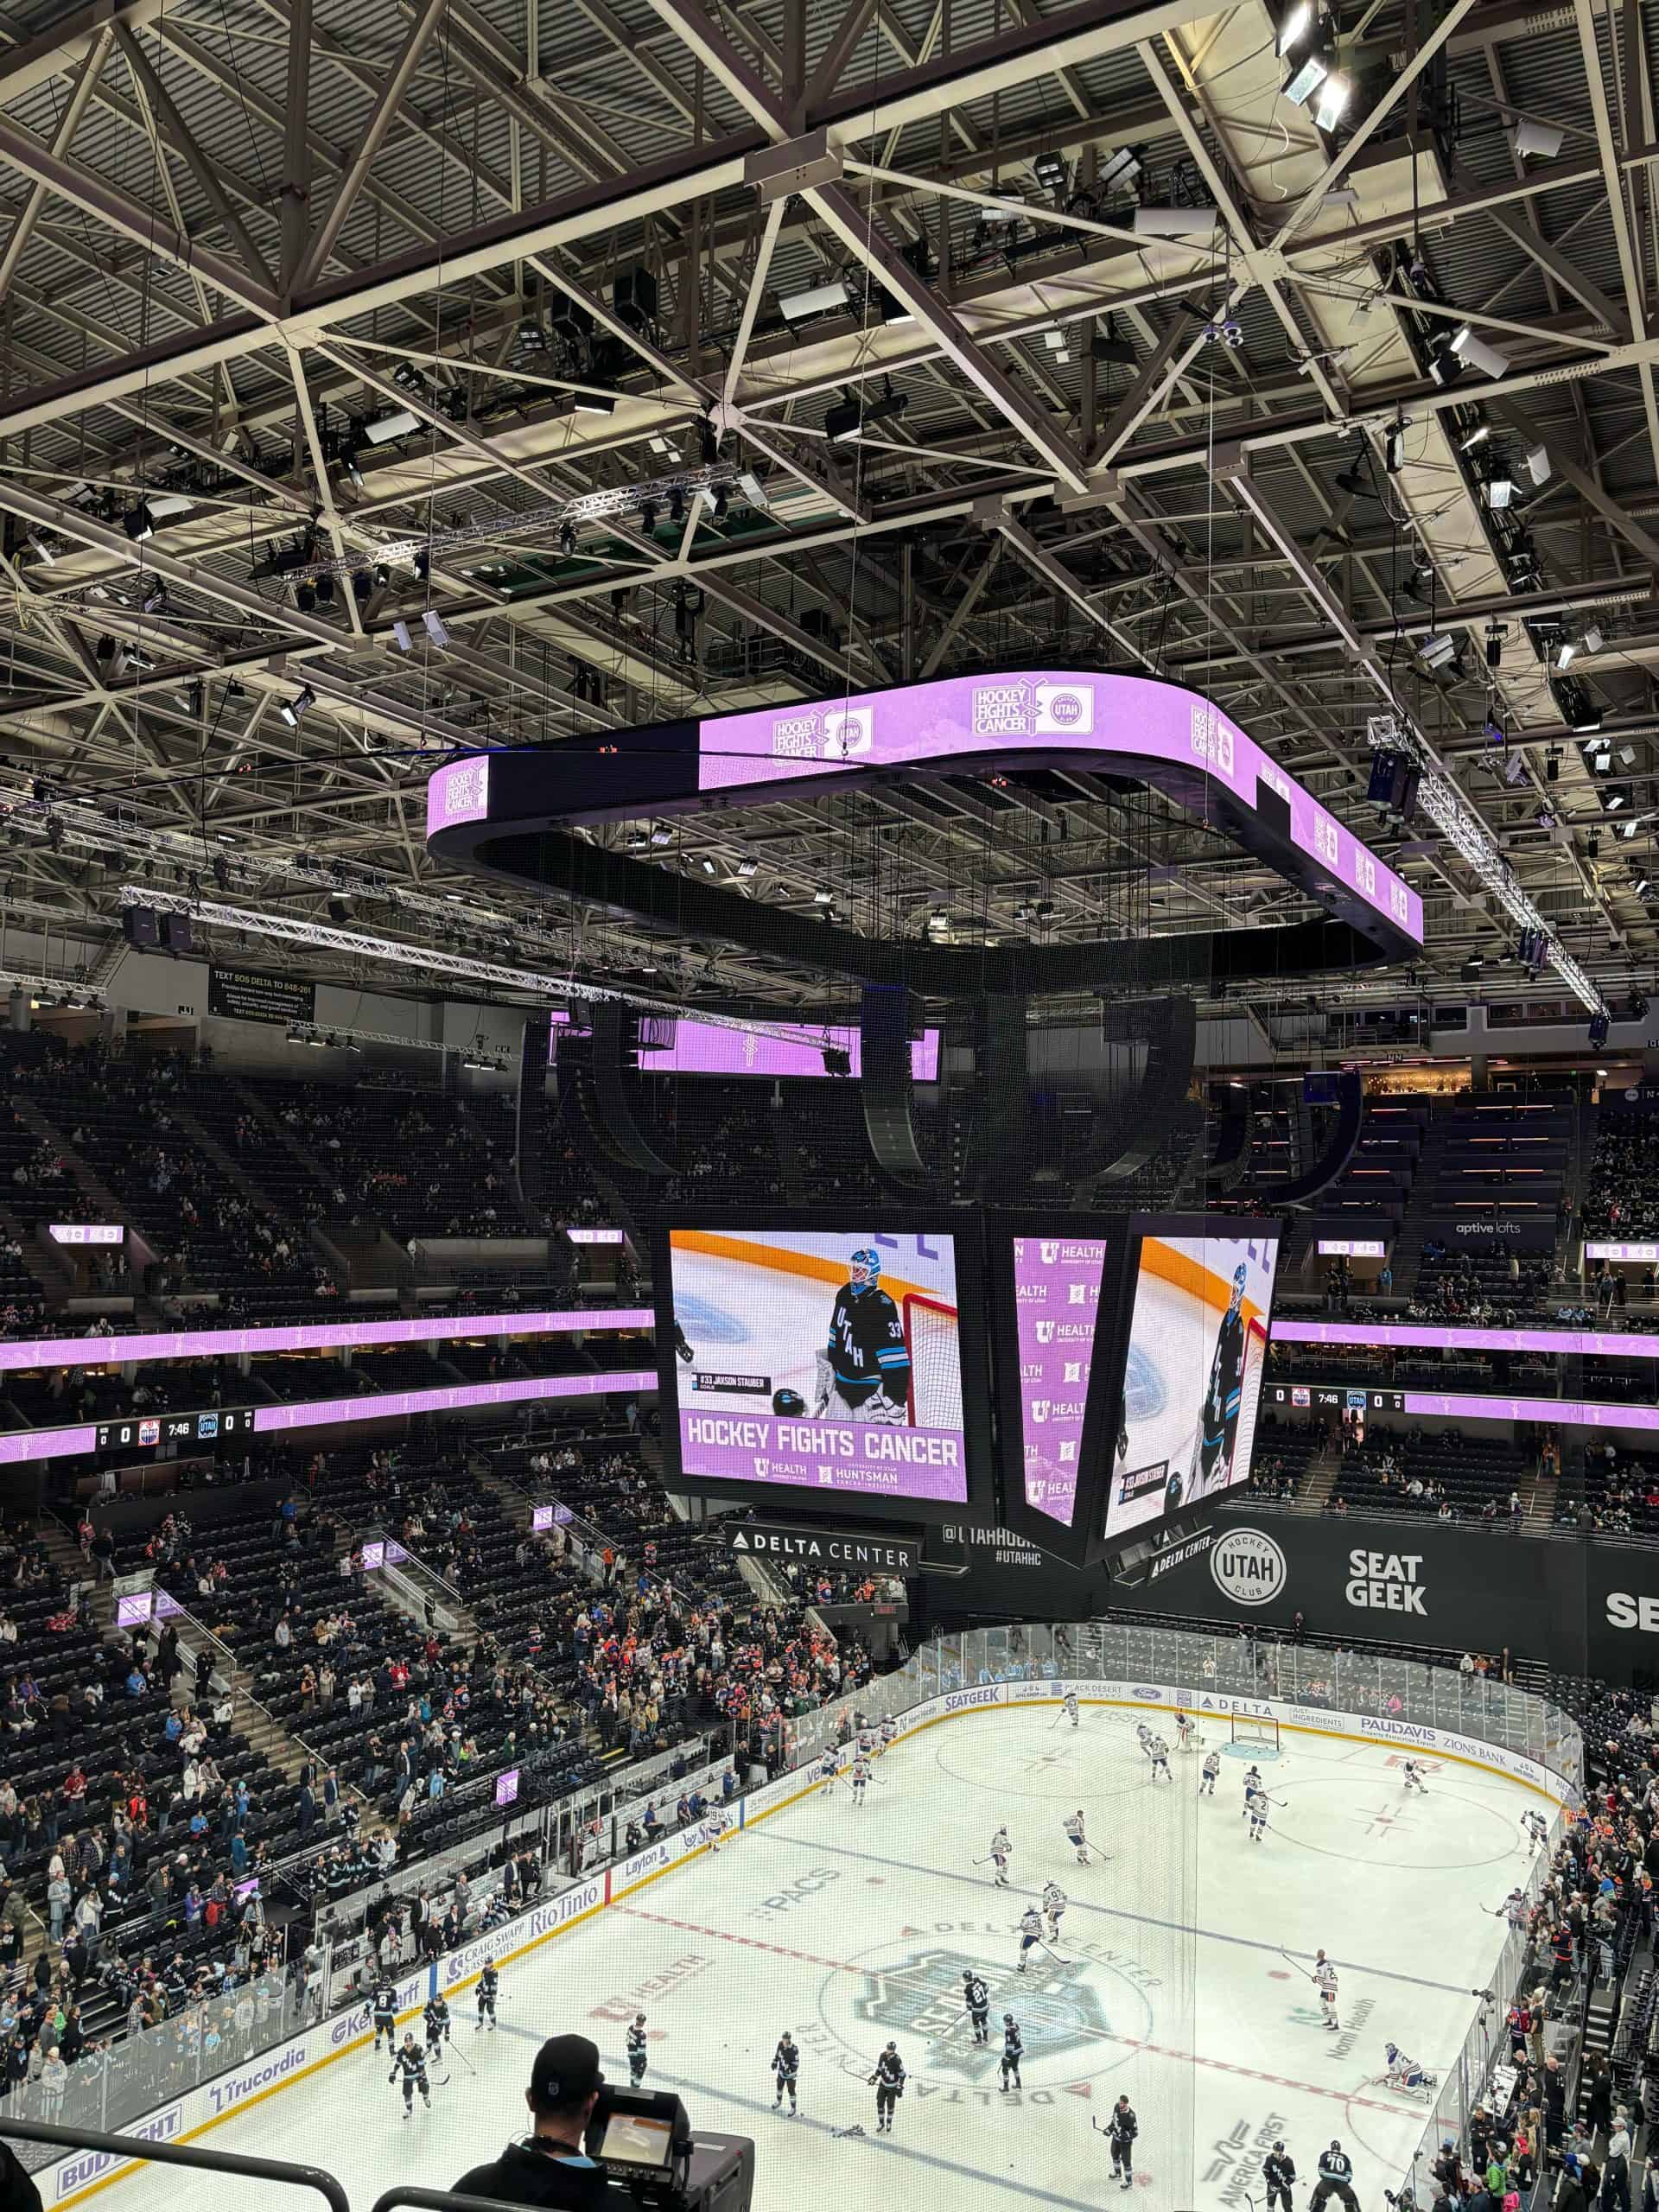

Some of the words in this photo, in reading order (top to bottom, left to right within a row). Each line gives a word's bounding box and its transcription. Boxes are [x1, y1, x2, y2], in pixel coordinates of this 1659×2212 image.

[977, 690, 1026, 704] HOCKEY
[977, 702, 1020, 719] FIGHTS
[1055, 704, 1078, 715] UTAH
[778, 719, 817, 734] HOCKEY
[976, 716, 1026, 733] CANCER
[777, 731, 812, 749] FIGHTS
[213, 969, 234, 981] TEXT
[234, 974, 250, 984] SOS
[251, 976, 272, 988] DELTA
[274, 981, 283, 989] TO
[1456, 1222, 1494, 1236] aptive
[1495, 1221, 1522, 1234] lofts
[1061, 1246, 1103, 1259] HEALTH
[887, 1321, 902, 1339] 33
[1275, 1389, 1285, 1402] 0
[1318, 1394, 1338, 1404] 7:46
[1349, 1395, 1364, 1405] UTAH
[1374, 1395, 1383, 1408] 0
[168, 1422, 189, 1437] 7:46
[200, 1421, 217, 1432] UTAH
[226, 1415, 234, 1430] 0
[121, 1427, 130, 1443] 0
[688, 1416, 771, 1450] HOCKEY
[779, 1425, 855, 1459] FIGHTS
[865, 1432, 958, 1467] CANCER
[772, 1460, 808, 1477] HEALTH
[836, 1467, 899, 1485] HUNTSMAN
[753, 1533, 821, 1556] DELTA
[829, 1542, 910, 1568] CENTER
[1227, 1536, 1270, 1554] HOCKEY
[995, 1549, 1041, 1566] #UTAHHC
[1160, 1549, 1184, 1573] DELTA
[1184, 1535, 1211, 1560] CENTER
[1222, 1553, 1274, 1583] UTAH
[1349, 1548, 1424, 1583] SEAT
[1234, 1585, 1263, 1597] CLUB
[1344, 1579, 1428, 1617] GEEK
[944, 1686, 1000, 1713] SEATGEEK
[1218, 1699, 1274, 1717] DELTA
[1293, 1714, 1342, 1727] INGREDIENTS
[1443, 1737, 1478, 1756] ZIONS
[1478, 1747, 1508, 1767] BANK
[625, 1850, 658, 1877] Layton
[530, 1908, 558, 1939] Rio
[559, 1885, 598, 1922] Tinto
[464, 1936, 494, 1963] CRAIG
[496, 1921, 525, 1946] SWAPP
[379, 1995, 387, 2007] 8
[1343, 1998, 1376, 2031] Health
[226, 2049, 306, 2102] Trucordia
[1217, 2146, 1268, 2209] AMERICA
[1255, 2112, 1289, 2152] FIRST
[1326, 2156, 1345, 2172] 70
